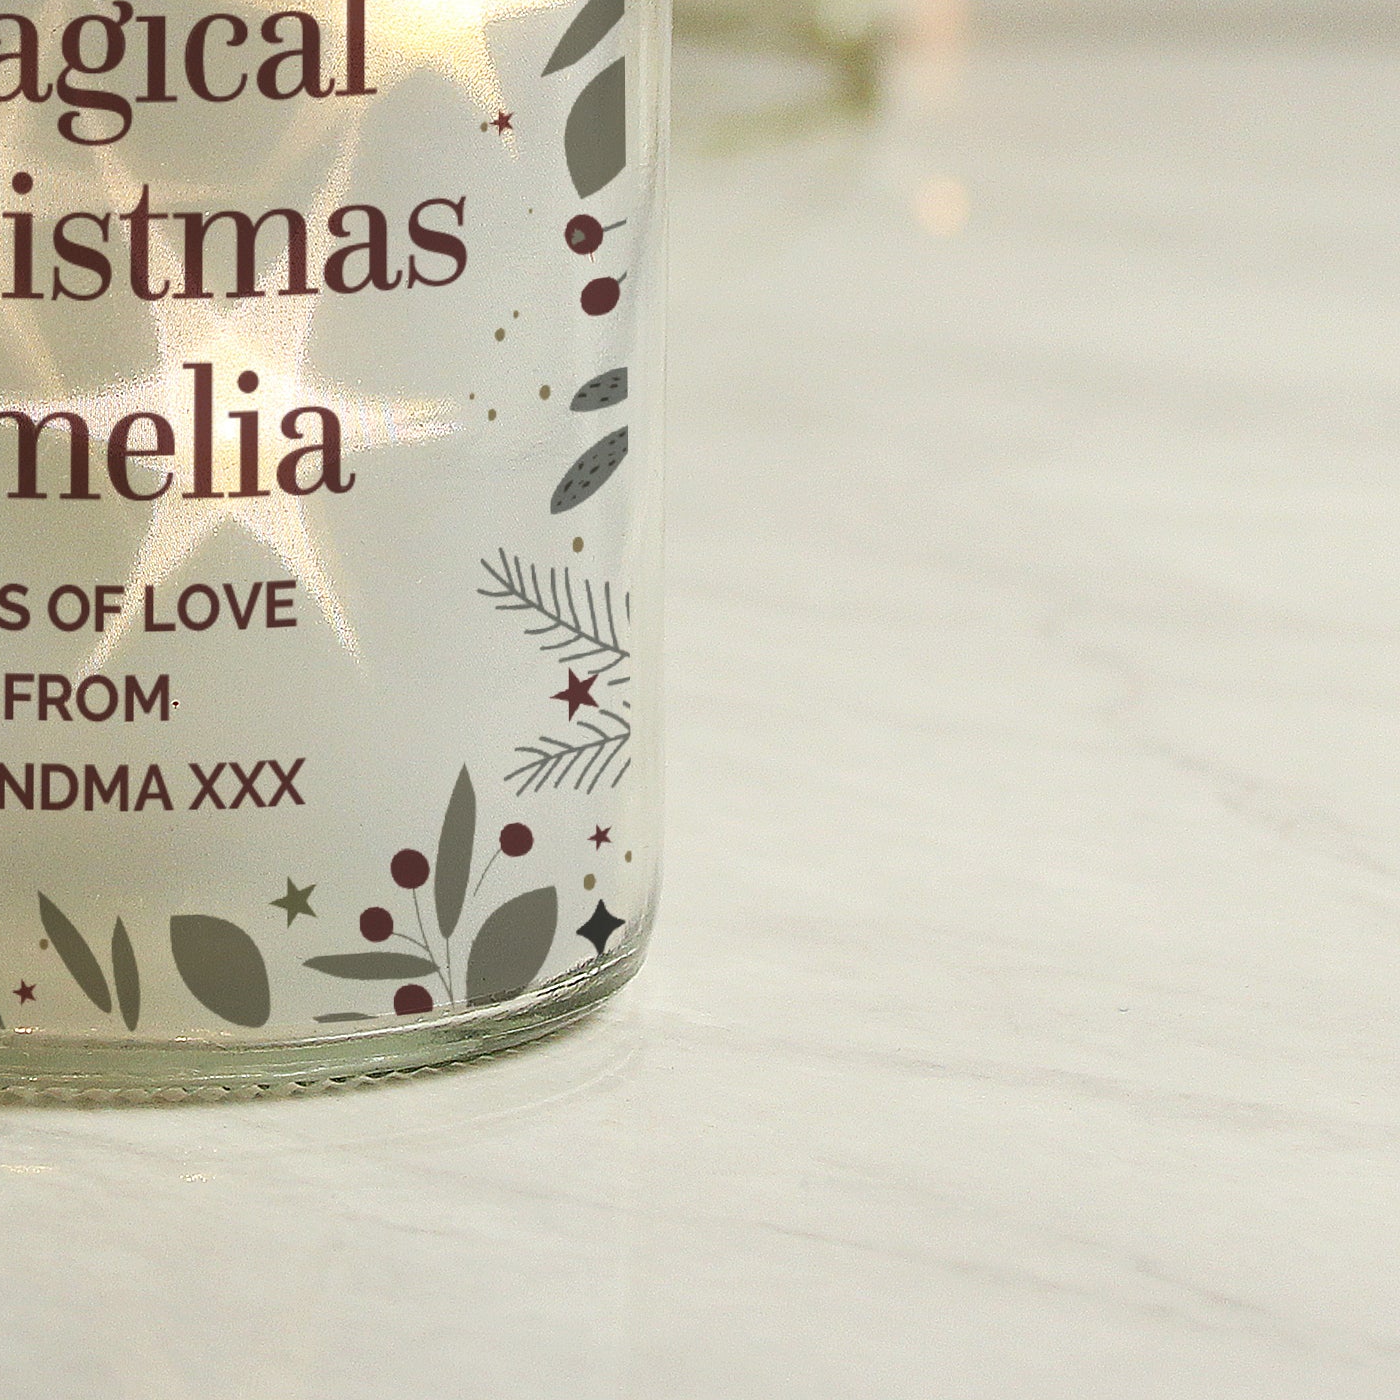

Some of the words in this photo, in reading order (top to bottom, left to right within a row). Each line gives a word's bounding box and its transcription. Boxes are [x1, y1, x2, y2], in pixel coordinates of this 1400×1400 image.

[47, 584, 125, 633] OF
[144, 579, 298, 632] LOVE
[3, 672, 171, 722] FROM
[188, 757, 307, 810] XXX
